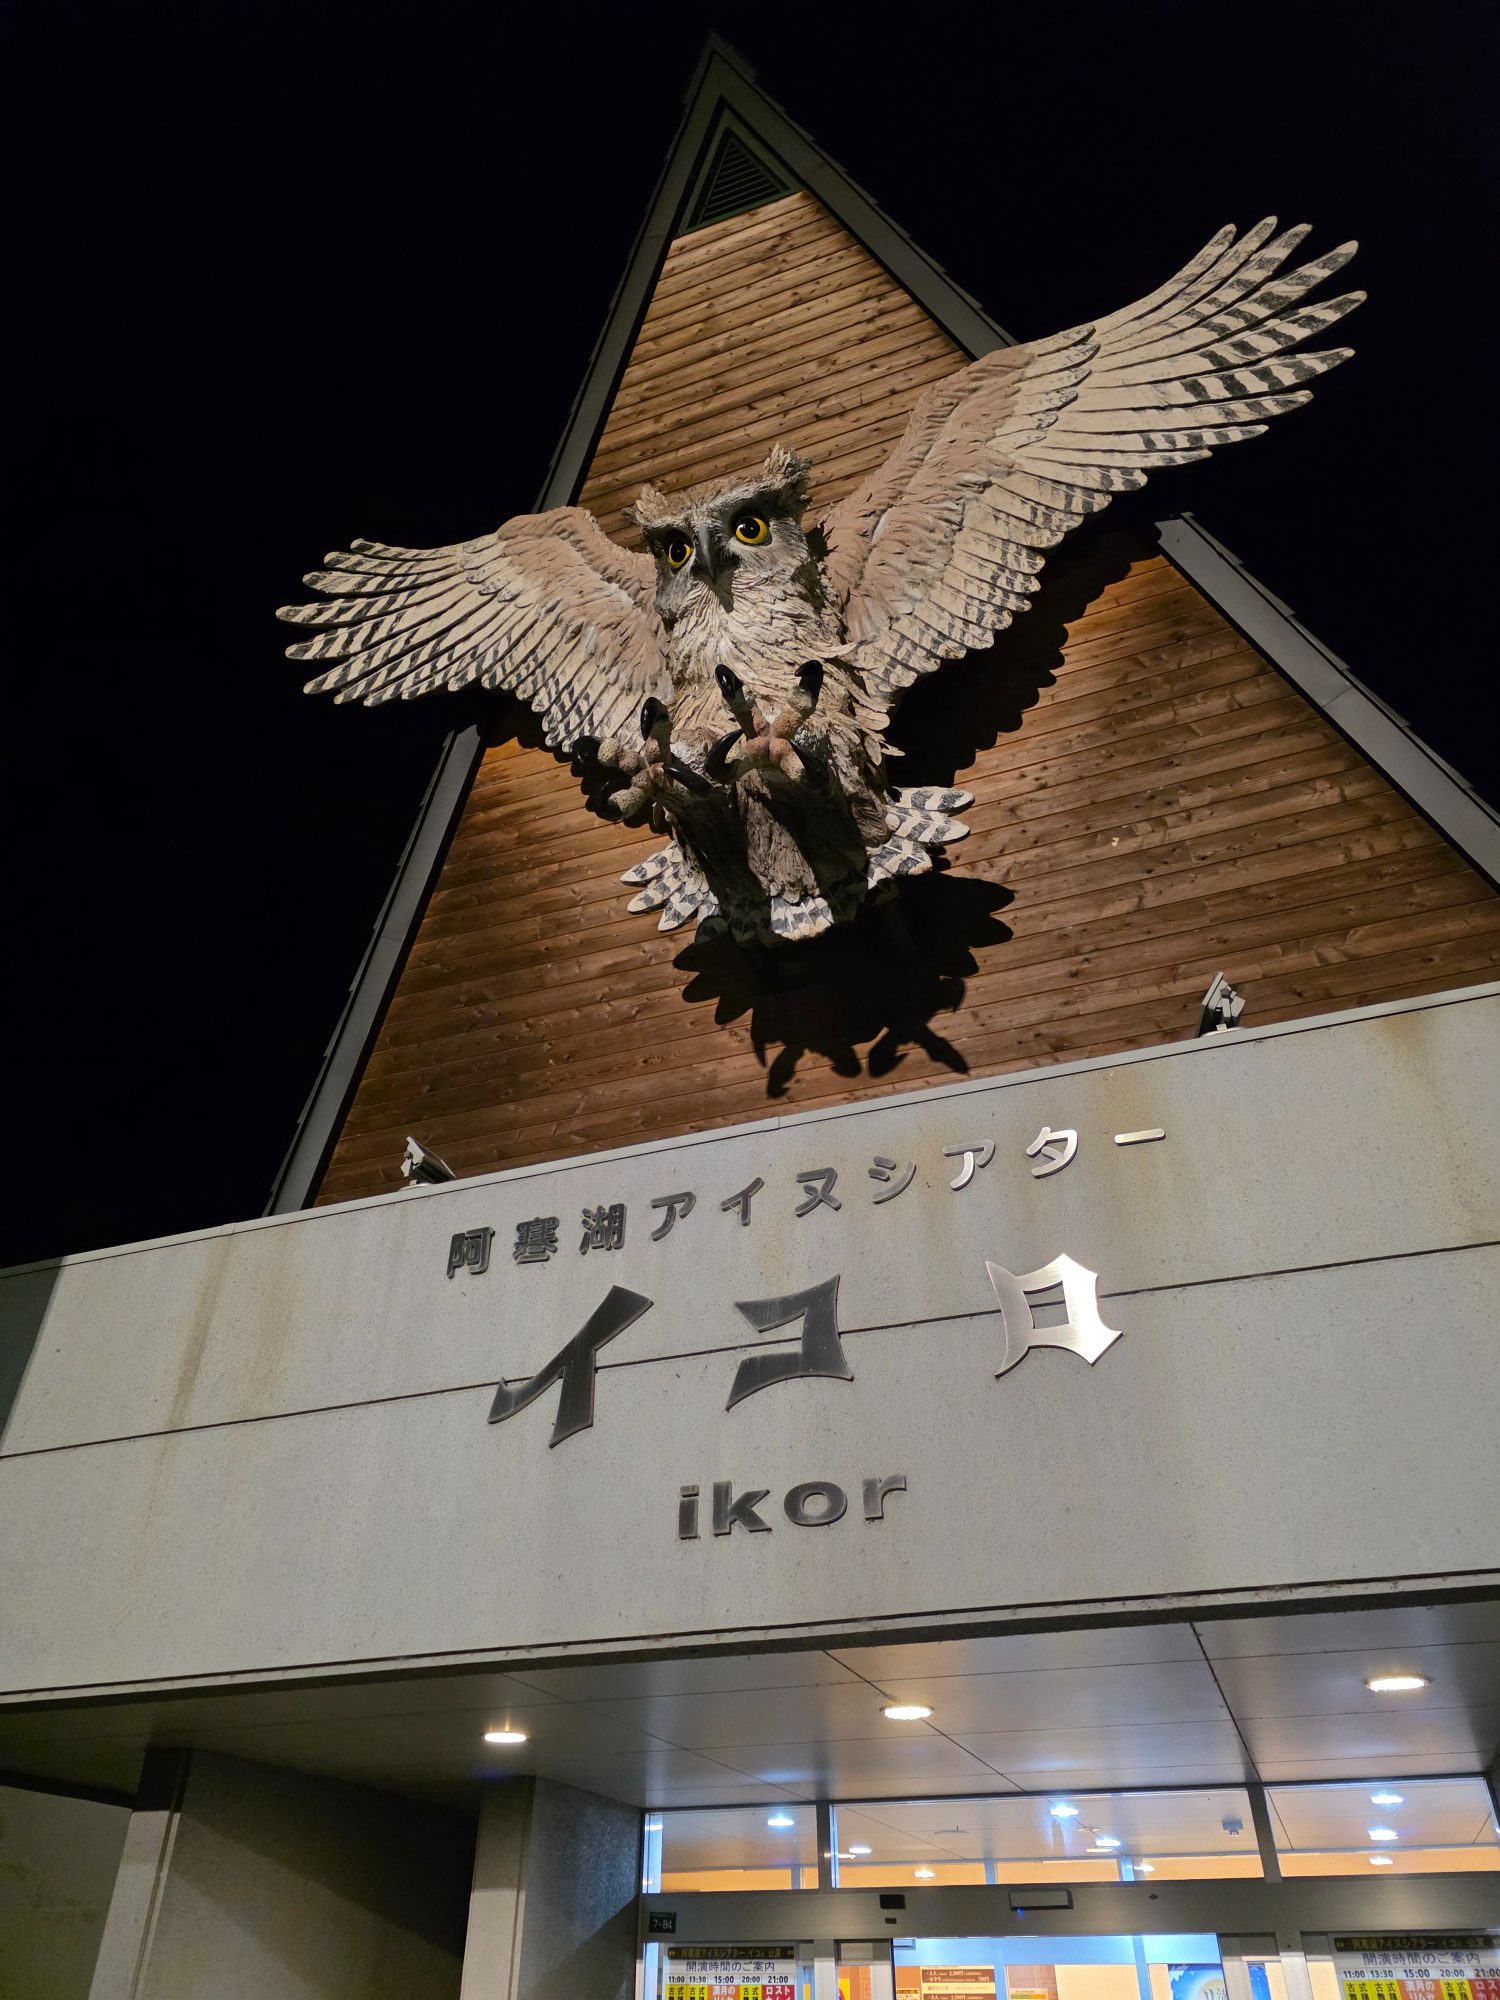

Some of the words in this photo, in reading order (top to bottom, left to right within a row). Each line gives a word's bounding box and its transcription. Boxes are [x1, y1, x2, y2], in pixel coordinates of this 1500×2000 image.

[447, 1126, 1166, 1279] 阿寒湖アイヌシアター
[487, 1253, 1123, 1449] イコロ
[678, 1475, 907, 1540] ikor
[1363, 1951, 1481, 1966] 開演時間のご案内
[686, 1961, 776, 1973] 開演時間のご案内
[1343, 1970, 1366, 1979] 11:00
[1370, 1970, 1394, 1979] 13:30
[1403, 1969, 1431, 1979] 15:00
[1440, 1969, 1466, 1978] 20:00
[668, 1975, 684, 1984] 11:00
[689, 1975, 707, 1984] 13:30
[714, 1975, 735, 1984] 15:00
[741, 1975, 761, 1984] 20:00
[768, 1975, 789, 1984] 21:00
